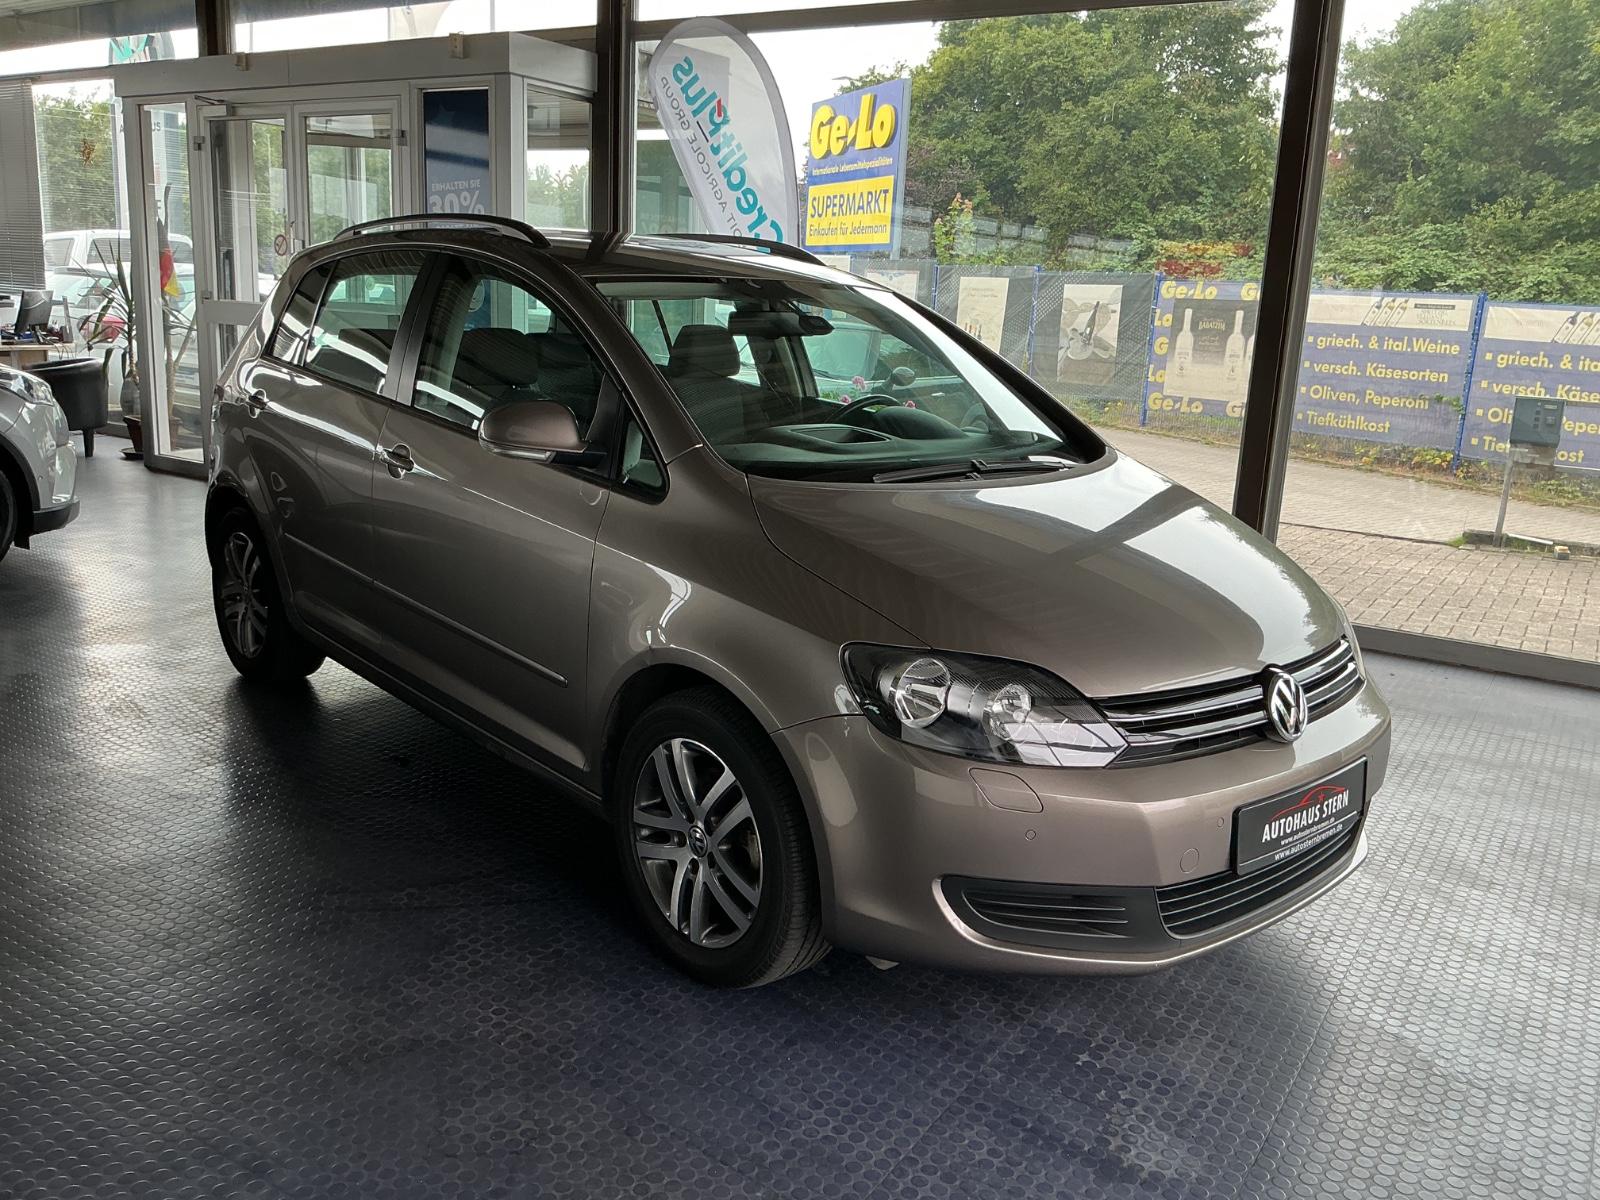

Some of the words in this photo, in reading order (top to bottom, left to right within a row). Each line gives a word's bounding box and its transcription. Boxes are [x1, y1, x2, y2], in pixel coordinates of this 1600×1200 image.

[431, 180, 469, 192] ERHALTEN
[470, 179, 481, 188] SIE
[429, 191, 485, 214] 30%
[810, 189, 889, 219] SUPERMARKT
[809, 222, 838, 237] Einkaufen
[839, 222, 848, 236] für
[850, 220, 887, 236] Jedermann
[1316, 333, 1364, 349] griech.
[1368, 336, 1379, 350] &
[1496, 350, 1554, 368] griech.
[1560, 354, 1572, 369] &
[1313, 361, 1361, 376] versch.
[1366, 362, 1449, 383] Käsesorten
[1309, 385, 1360, 405] Oliven,
[1364, 389, 1429, 410] Peperoni
[1492, 381, 1551, 398] versch.
[1306, 410, 1391, 433] Tiefkühlkost
[1262, 804, 1320, 843] AUTOHAUS
[1322, 790, 1349, 818] STERN
[1274, 824, 1343, 861] www.autosternbremen.de
